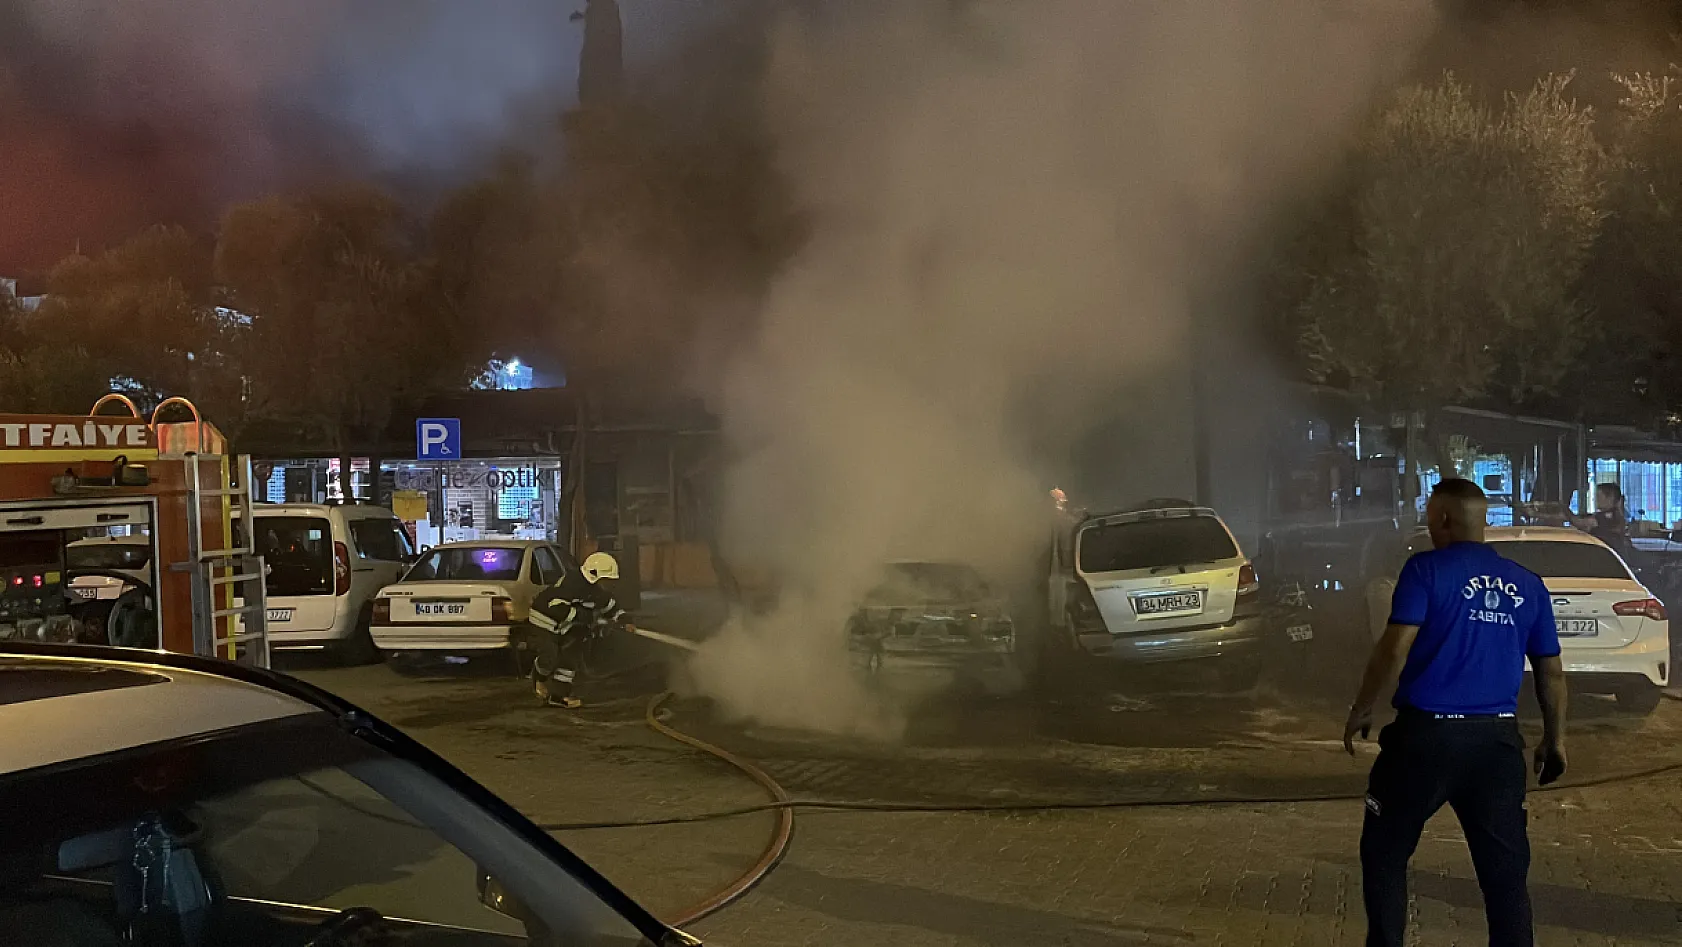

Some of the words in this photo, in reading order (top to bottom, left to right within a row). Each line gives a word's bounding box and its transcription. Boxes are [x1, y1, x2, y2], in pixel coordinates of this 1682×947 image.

[422, 423, 449, 455] P
[487, 461, 545, 494] optik
[1143, 599, 1156, 610] 34
[1184, 595, 1198, 605] 23
[1468, 608, 1516, 626] ZABITA
